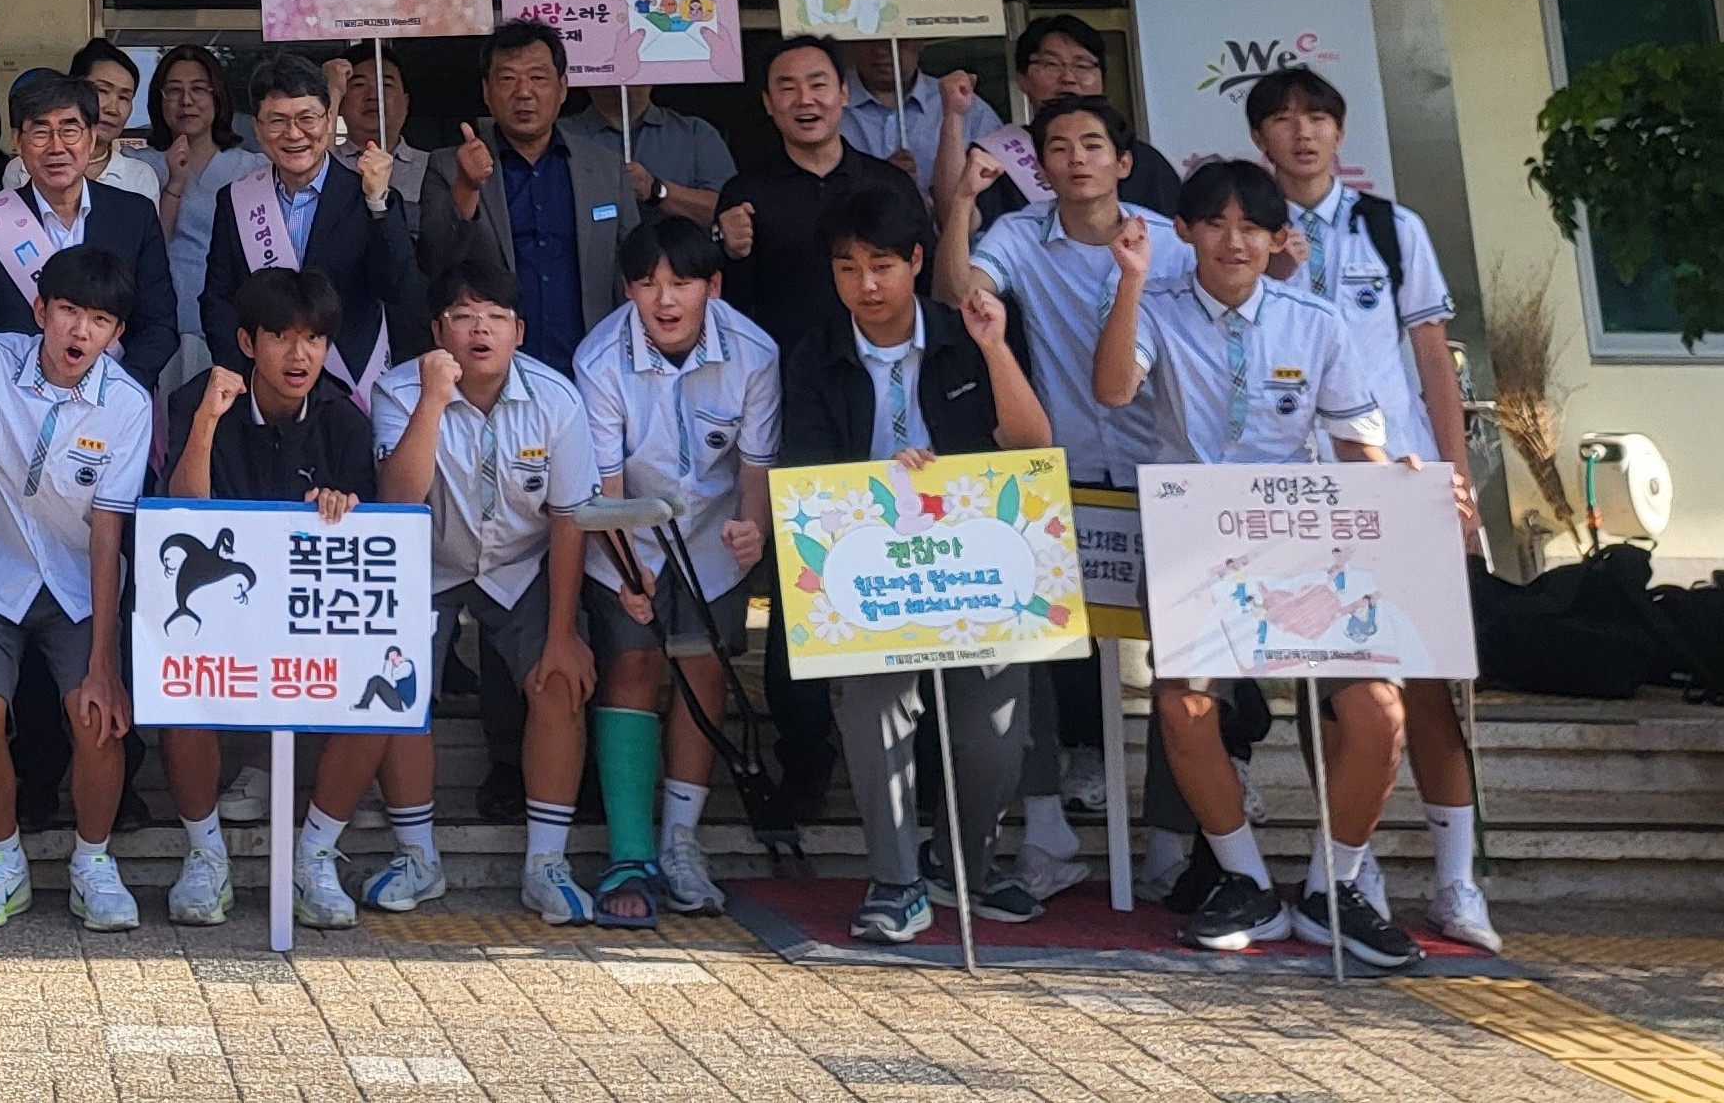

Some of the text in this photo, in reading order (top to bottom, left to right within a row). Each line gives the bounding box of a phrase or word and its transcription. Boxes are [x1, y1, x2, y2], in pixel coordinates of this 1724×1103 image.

[520, 2, 611, 24] 사랑스러운
[1250, 475, 1341, 506] 생명존중
[1218, 509, 1382, 540] 아름다운 동행
[288, 534, 398, 583] 폭력은
[288, 587, 399, 636] 한순간
[161, 654, 339, 701] 상처는 평생
